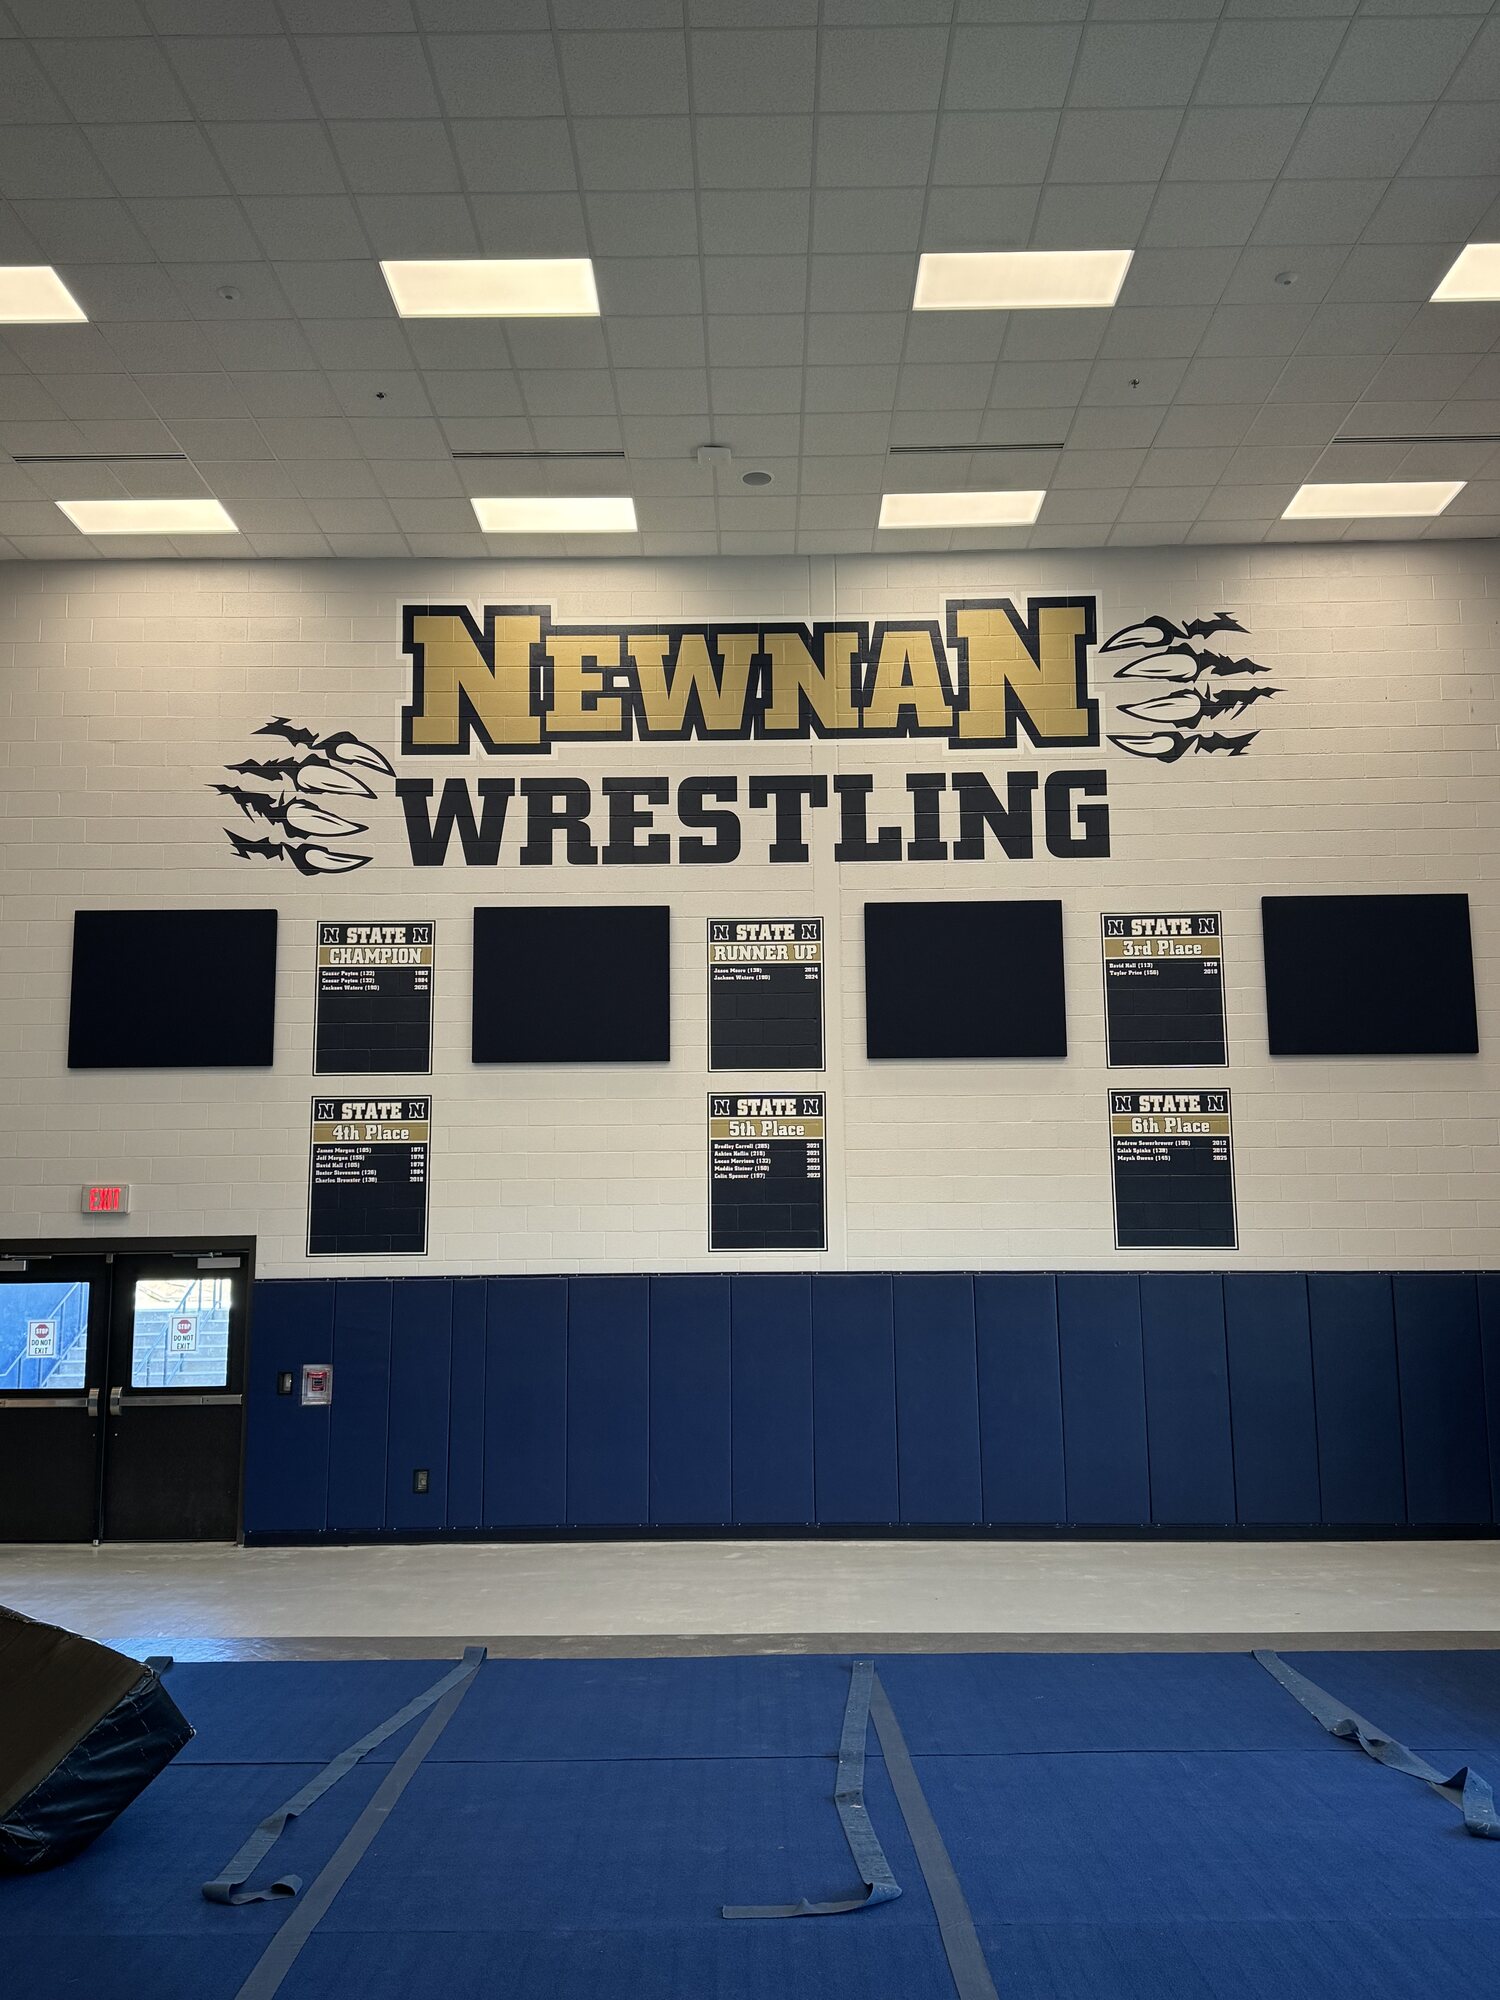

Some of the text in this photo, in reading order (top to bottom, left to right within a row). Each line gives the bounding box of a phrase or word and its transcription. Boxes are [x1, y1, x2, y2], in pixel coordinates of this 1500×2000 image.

[402, 596, 1098, 755] NEWNAN
[396, 770, 1111, 866] WRESTLING
[714, 924, 816, 940] N STATE N
[1108, 918, 1215, 935] N STATE N
[324, 927, 428, 944] N STATE N
[330, 948, 422, 963] CHAMPION
[715, 945, 817, 960] RUNNER UP
[1123, 940, 1202, 955] 3rd Place
[318, 1103, 424, 1119] N STATE N
[715, 1099, 819, 1115] N STATE N
[1116, 1095, 1224, 1112] N STATE N
[333, 1125, 409, 1140] 4th Place
[729, 1121, 805, 1136] 5th Place
[1131, 1118, 1210, 1132] 6th Place
[90, 1187, 121, 1211] EXIT
[35, 1328, 49, 1336] STOP
[177, 1323, 192, 1331] STOP
